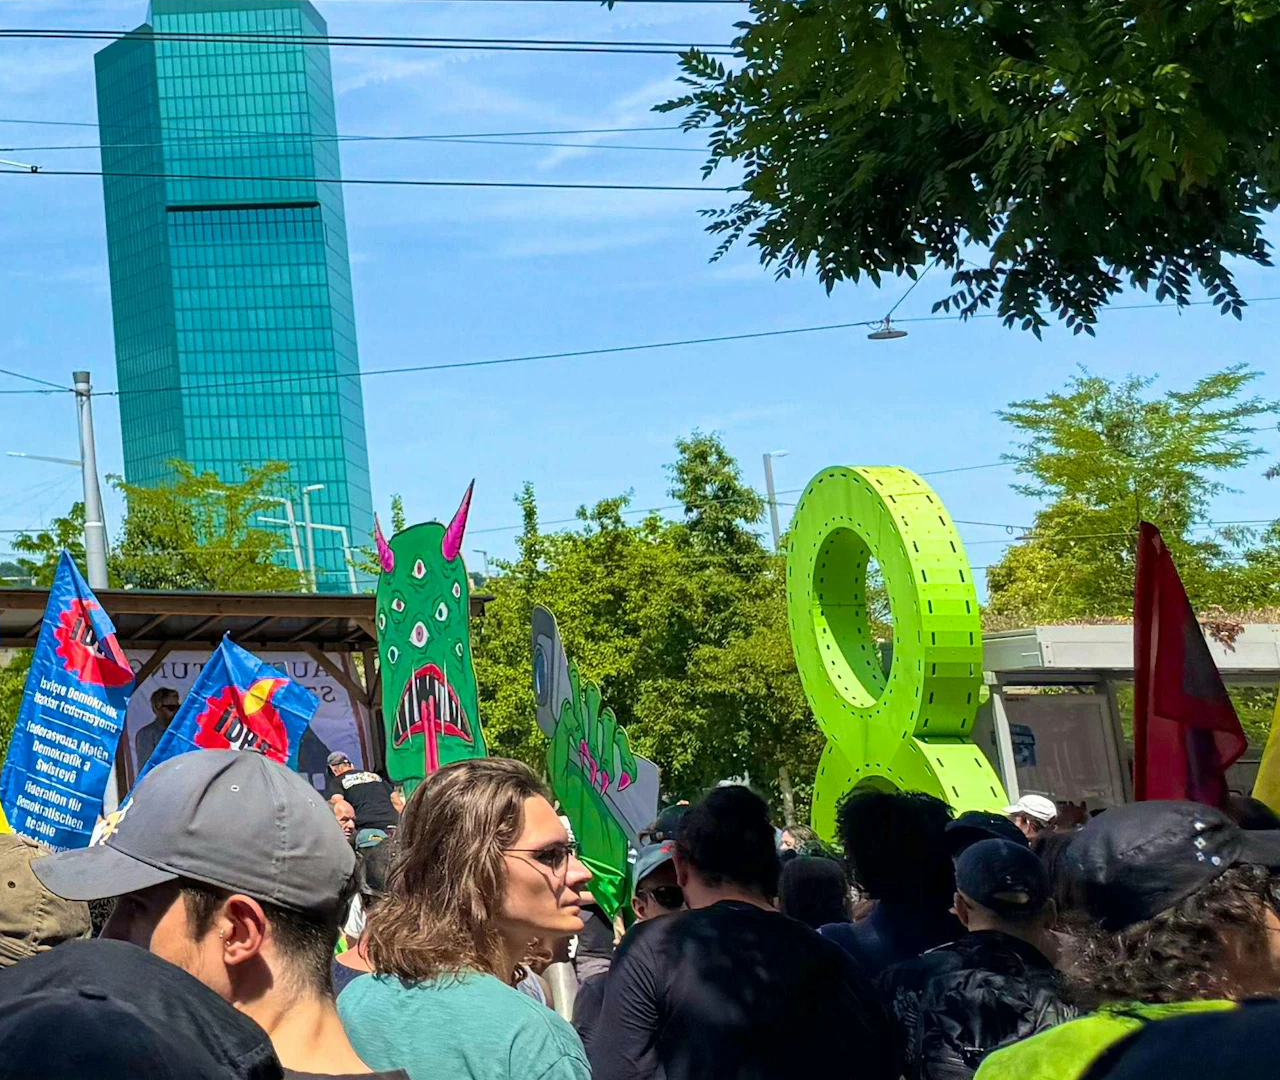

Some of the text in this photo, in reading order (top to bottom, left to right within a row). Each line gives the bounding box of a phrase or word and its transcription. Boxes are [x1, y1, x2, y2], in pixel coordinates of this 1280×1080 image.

[67, 686, 118, 720] Demokratik
[83, 760, 91, 772] a
[16, 794, 84, 831] Demokratischen
[24, 815, 57, 838] Rechte
